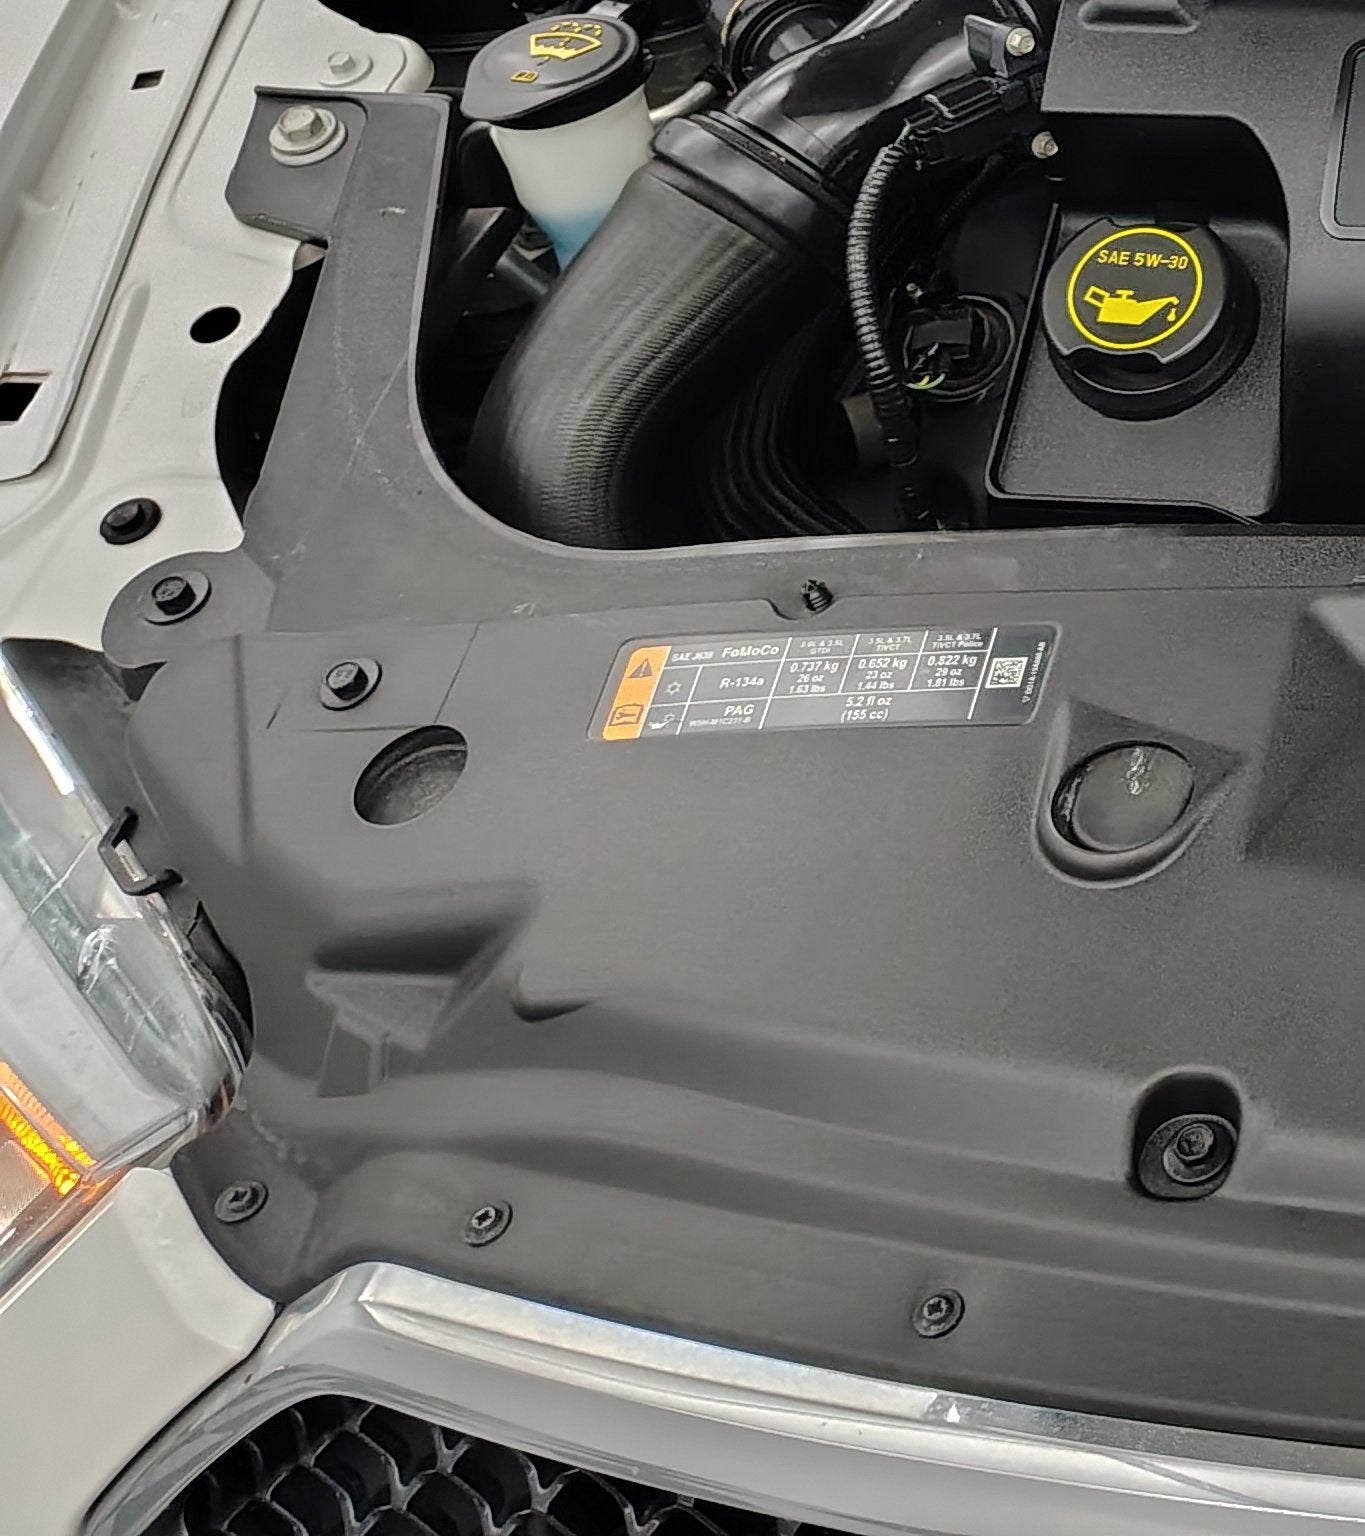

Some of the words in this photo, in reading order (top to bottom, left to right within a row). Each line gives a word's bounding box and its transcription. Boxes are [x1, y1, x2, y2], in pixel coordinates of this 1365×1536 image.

[1097, 249, 1132, 266] SAE
[1133, 252, 1189, 270] 5W-30
[721, 645, 779, 658] FoMoCo
[789, 660, 823, 673] 0.737
[823, 660, 839, 674] kg
[858, 657, 891, 670] 0.652
[891, 657, 908, 670] kg
[927, 654, 961, 667] 0.822
[961, 654, 978, 667] kg
[796, 673, 811, 683] 26
[811, 674, 825, 683] oz
[880, 670, 894, 679] oz
[935, 667, 949, 677] 29
[949, 667, 963, 676] oz
[719, 676, 765, 689] R-134a
[810, 684, 826, 693] lbs
[878, 681, 895, 690] lbs
[948, 677, 965, 687] lbs
[845, 696, 865, 707] 5.2
[865, 695, 876, 707] fl
[877, 696, 893, 706] oz
[724, 704, 755, 717] PAG
[840, 709, 867, 724] (155
[869, 708, 889, 722] cc)
